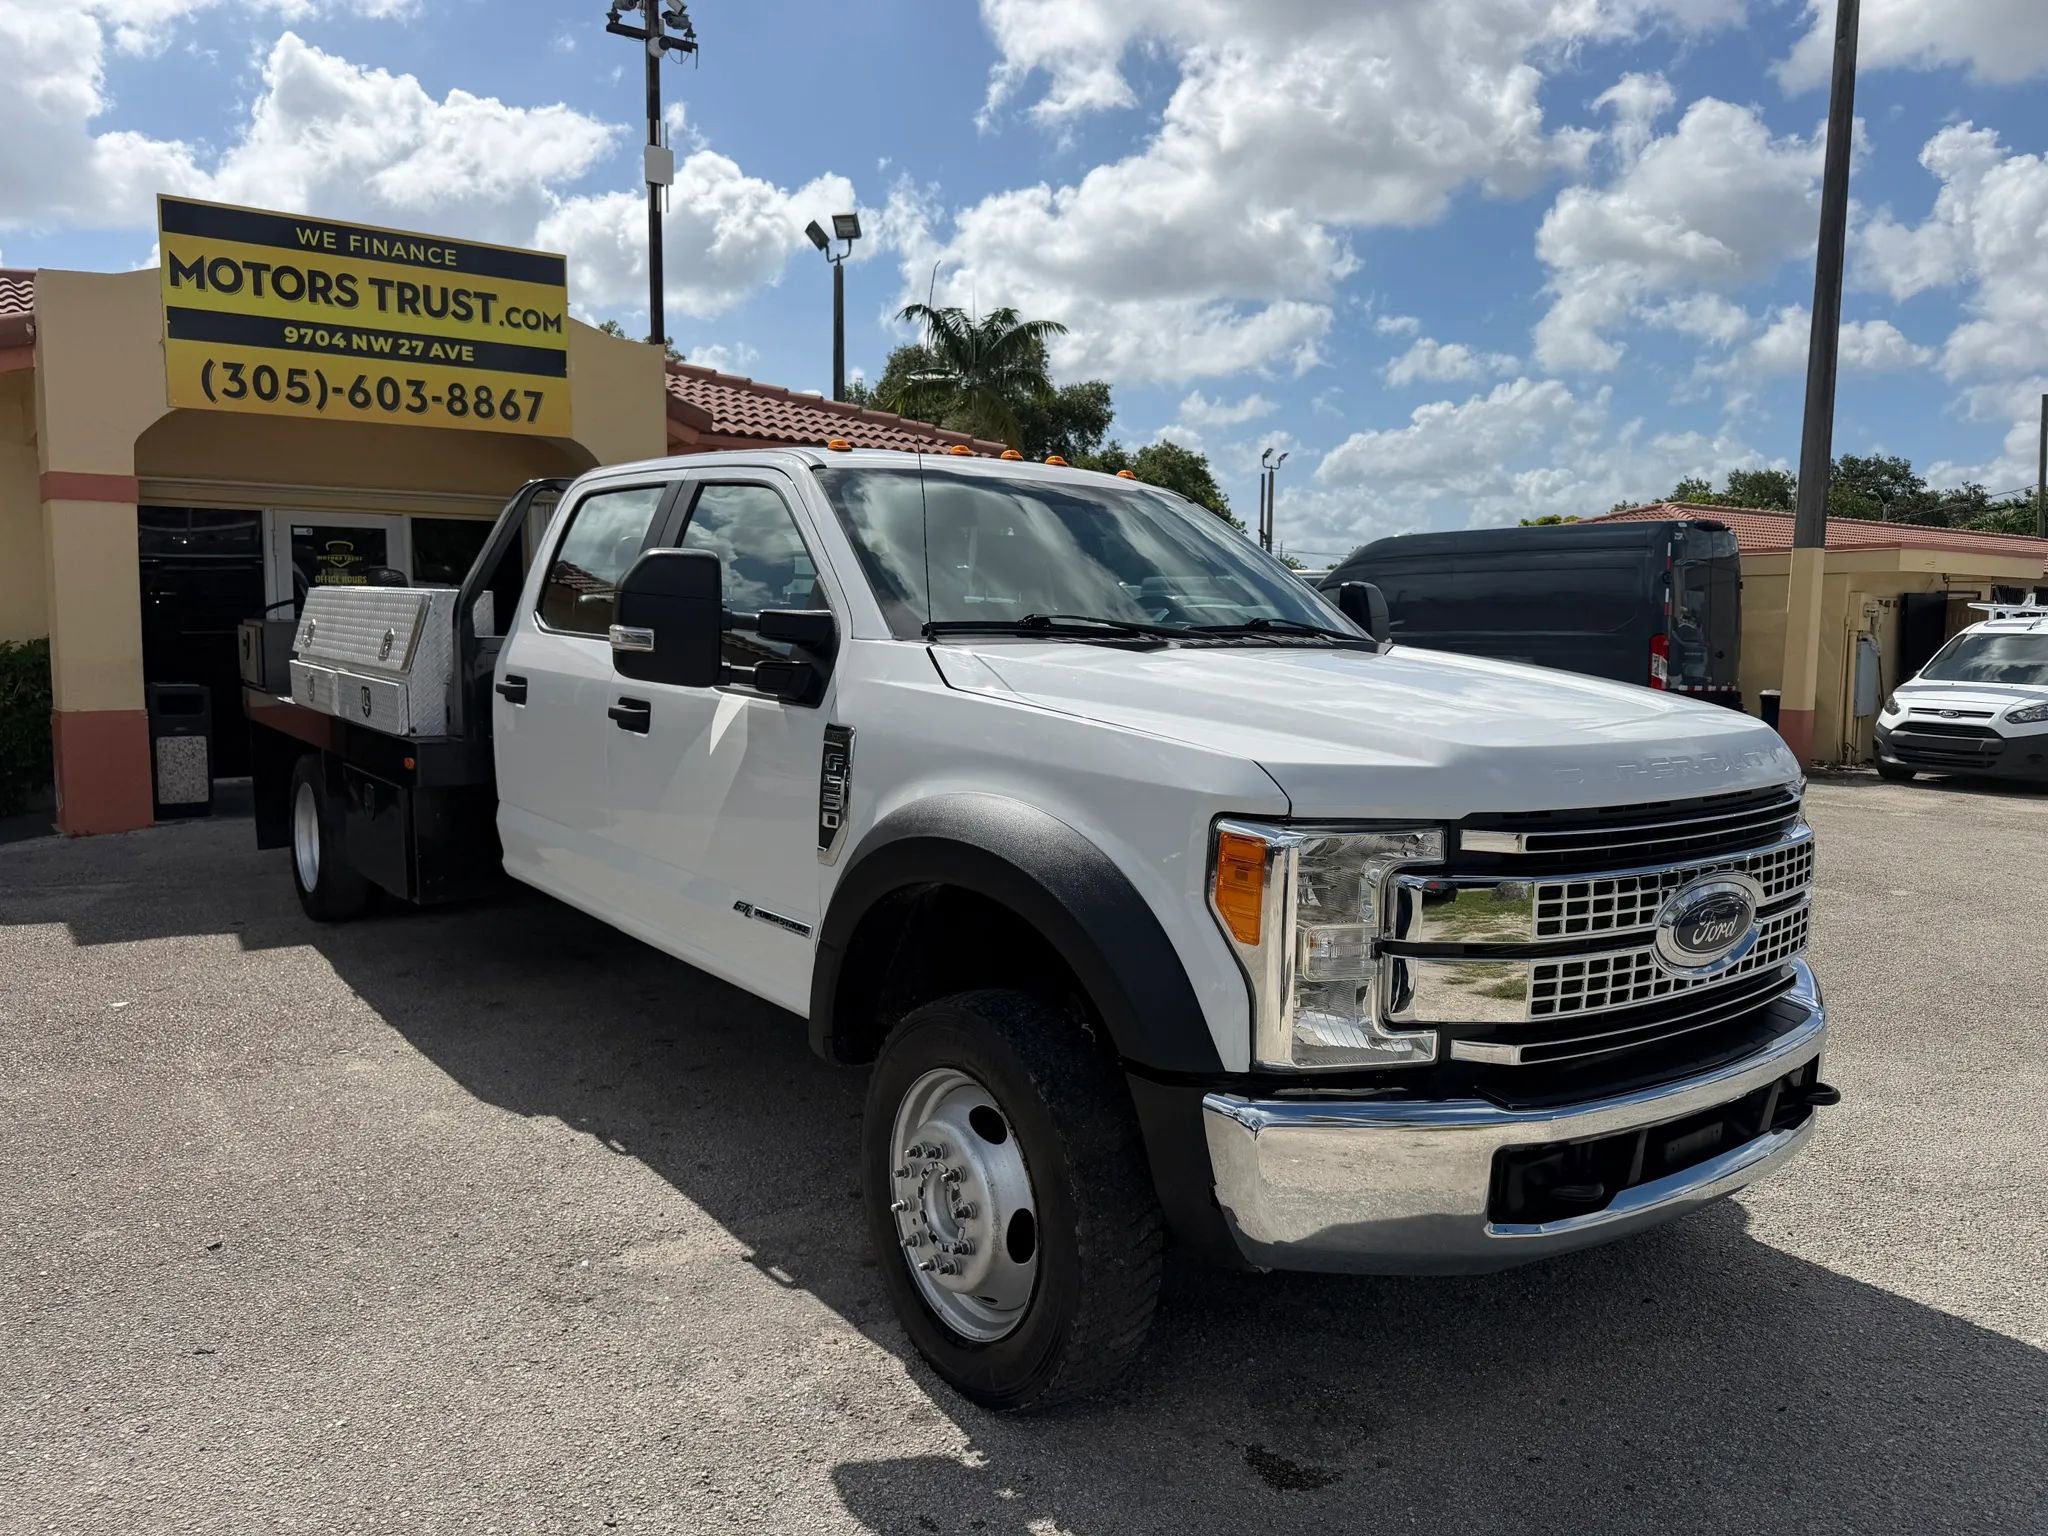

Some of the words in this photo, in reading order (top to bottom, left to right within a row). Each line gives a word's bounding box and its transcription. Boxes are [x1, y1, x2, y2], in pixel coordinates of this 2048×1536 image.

[296, 227, 337, 250] WE
[349, 235, 458, 266] FINANCE
[168, 250, 360, 309] MOTORS
[283, 325, 347, 349] 9704
[352, 333, 394, 354] NW
[399, 337, 424, 357] 27
[429, 341, 475, 363] AVE
[201, 358, 544, 424] (305)-603-8867
[1692, 905, 1739, 945] Ford
